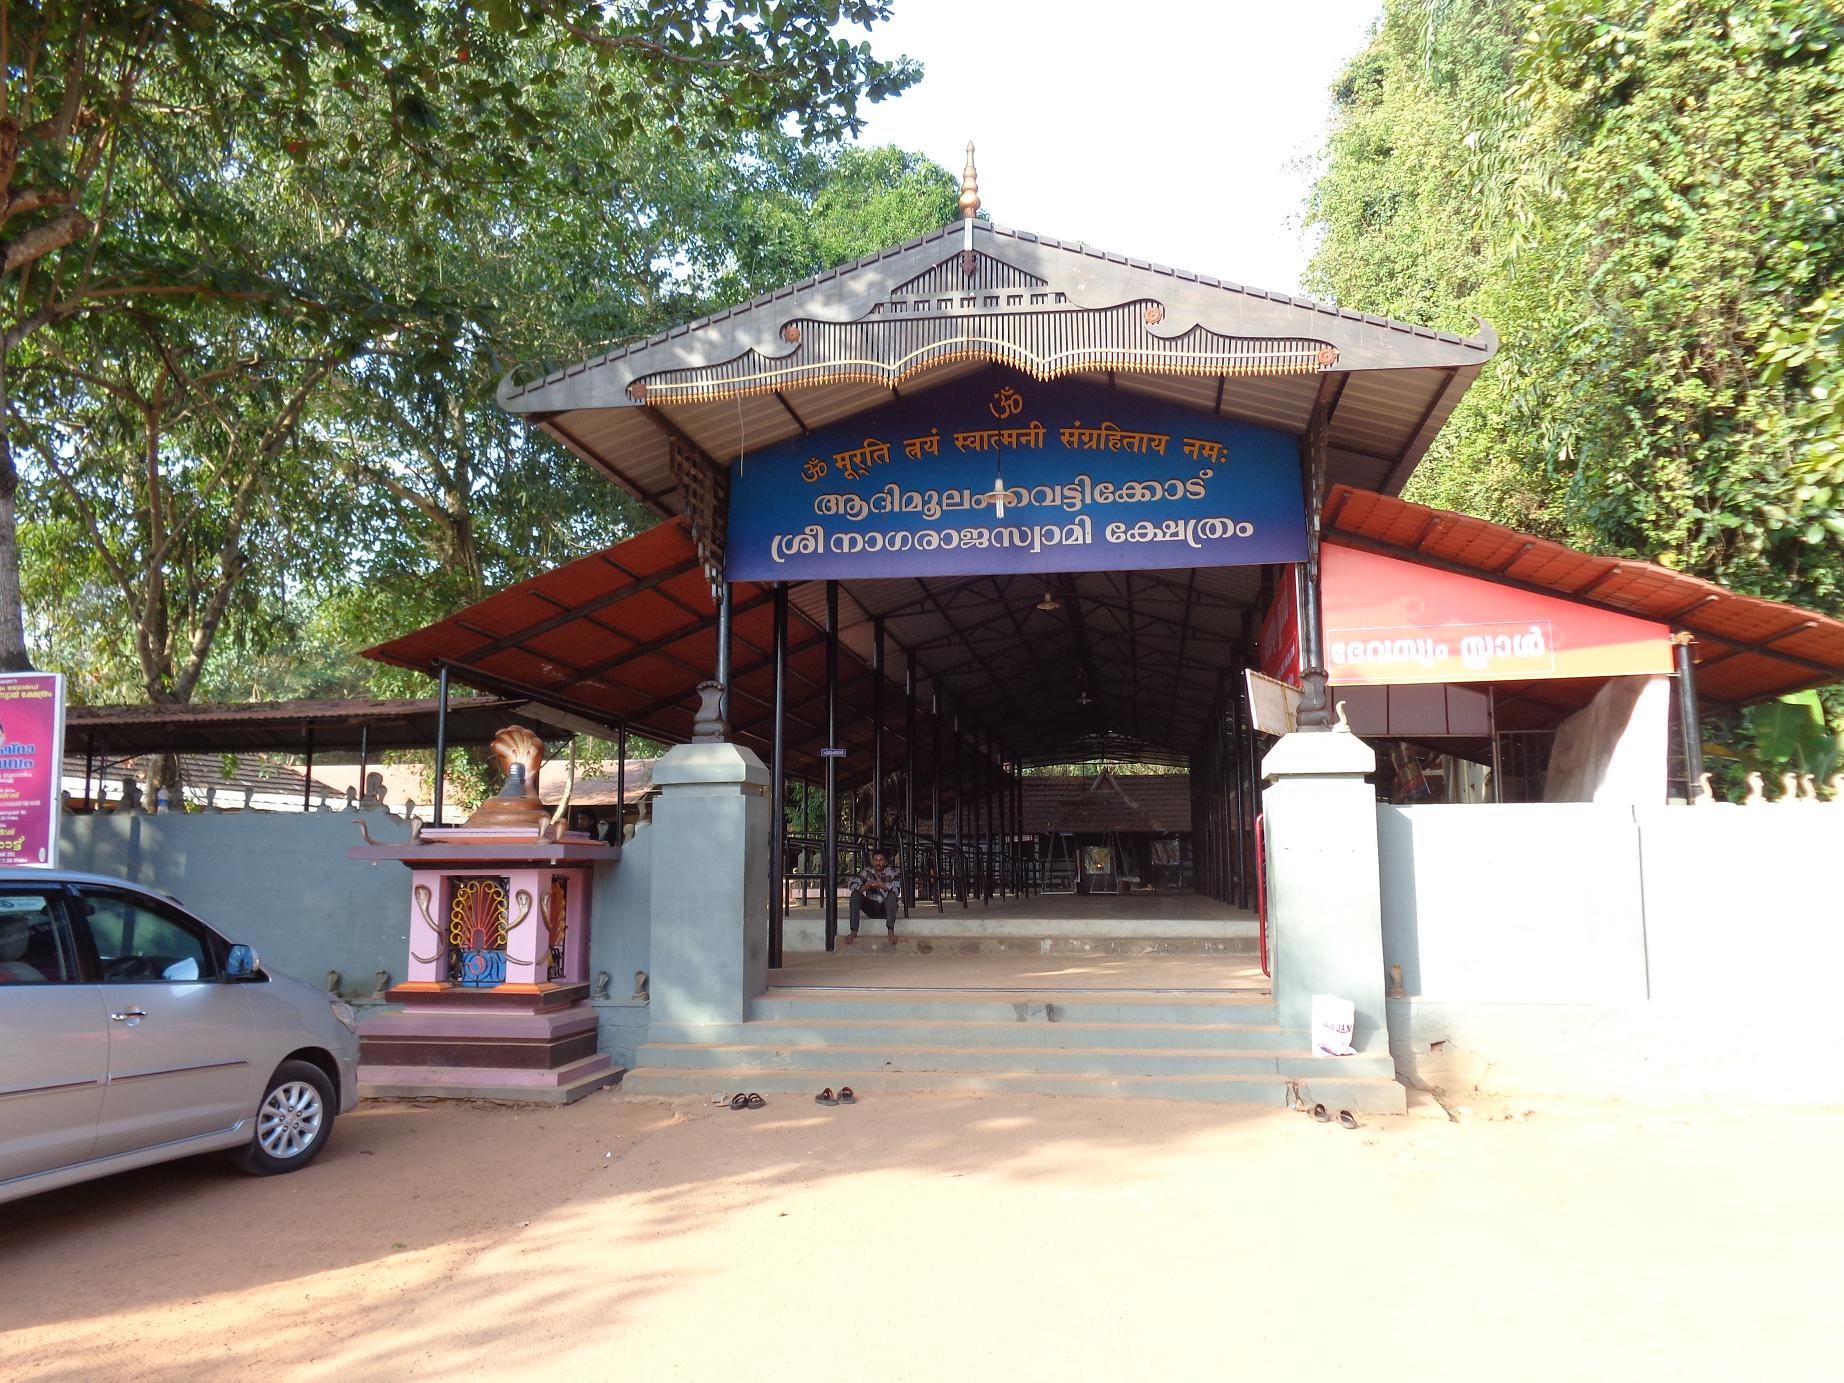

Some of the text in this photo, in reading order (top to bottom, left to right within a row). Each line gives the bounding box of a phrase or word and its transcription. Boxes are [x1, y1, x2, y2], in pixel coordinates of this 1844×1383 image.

[771, 515, 1254, 563] ശ്രീ നാഗരാജസ്വാമി ക്ഷേത്രം
